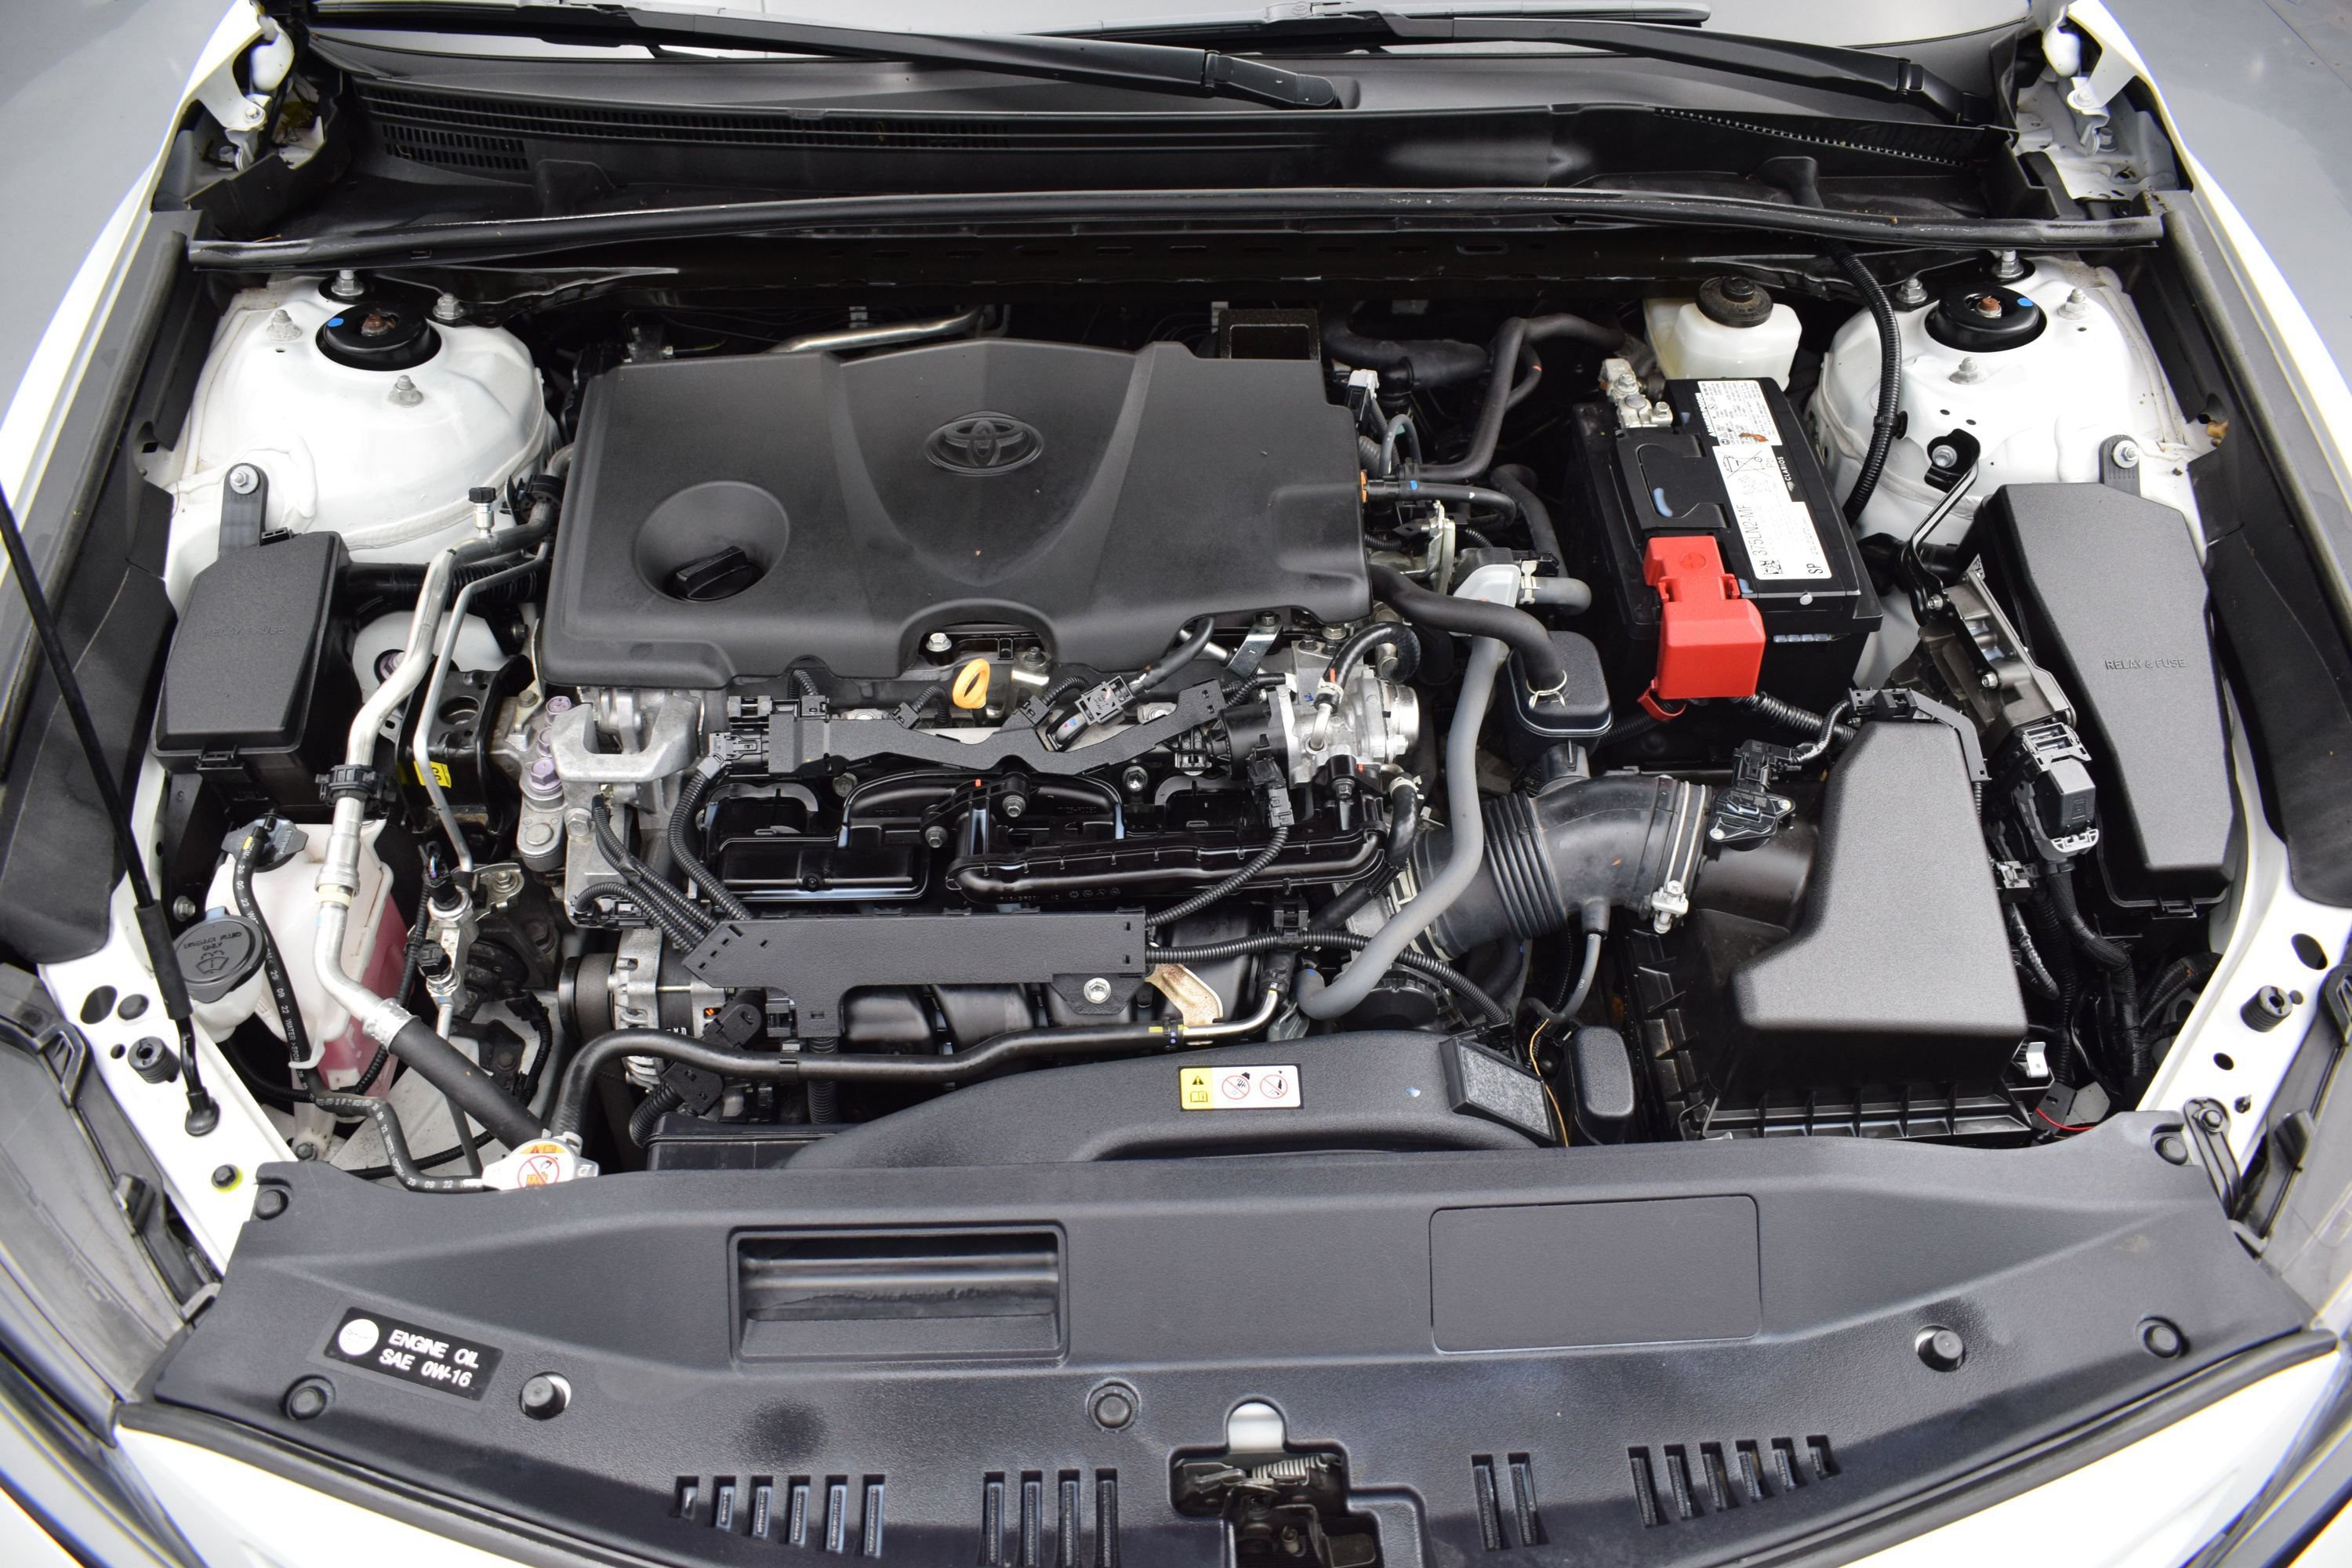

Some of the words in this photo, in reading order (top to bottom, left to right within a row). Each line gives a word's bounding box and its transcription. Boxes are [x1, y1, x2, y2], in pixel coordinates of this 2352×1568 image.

[1777, 456, 1791, 481] CLARIOS
[1737, 504, 1768, 556] 375LN2-MF
[1806, 563, 1824, 574] SP
[2104, 659, 2141, 670] RELAY
[2145, 659, 2153, 669] &
[2155, 659, 2186, 668] FUSE
[241, 898, 250, 907] 22
[270, 970, 280, 981] 29
[277, 988, 285, 999] 09
[281, 1005, 289, 1014] 22
[285, 1018, 296, 1041] WATER
[424, 1180, 435, 1189] 09
[443, 1180, 453, 1189] 22
[388, 1329, 449, 1359] ENGINE
[454, 1348, 479, 1369] OIL
[379, 1348, 416, 1370] SAE
[421, 1360, 473, 1387] 0W-16
